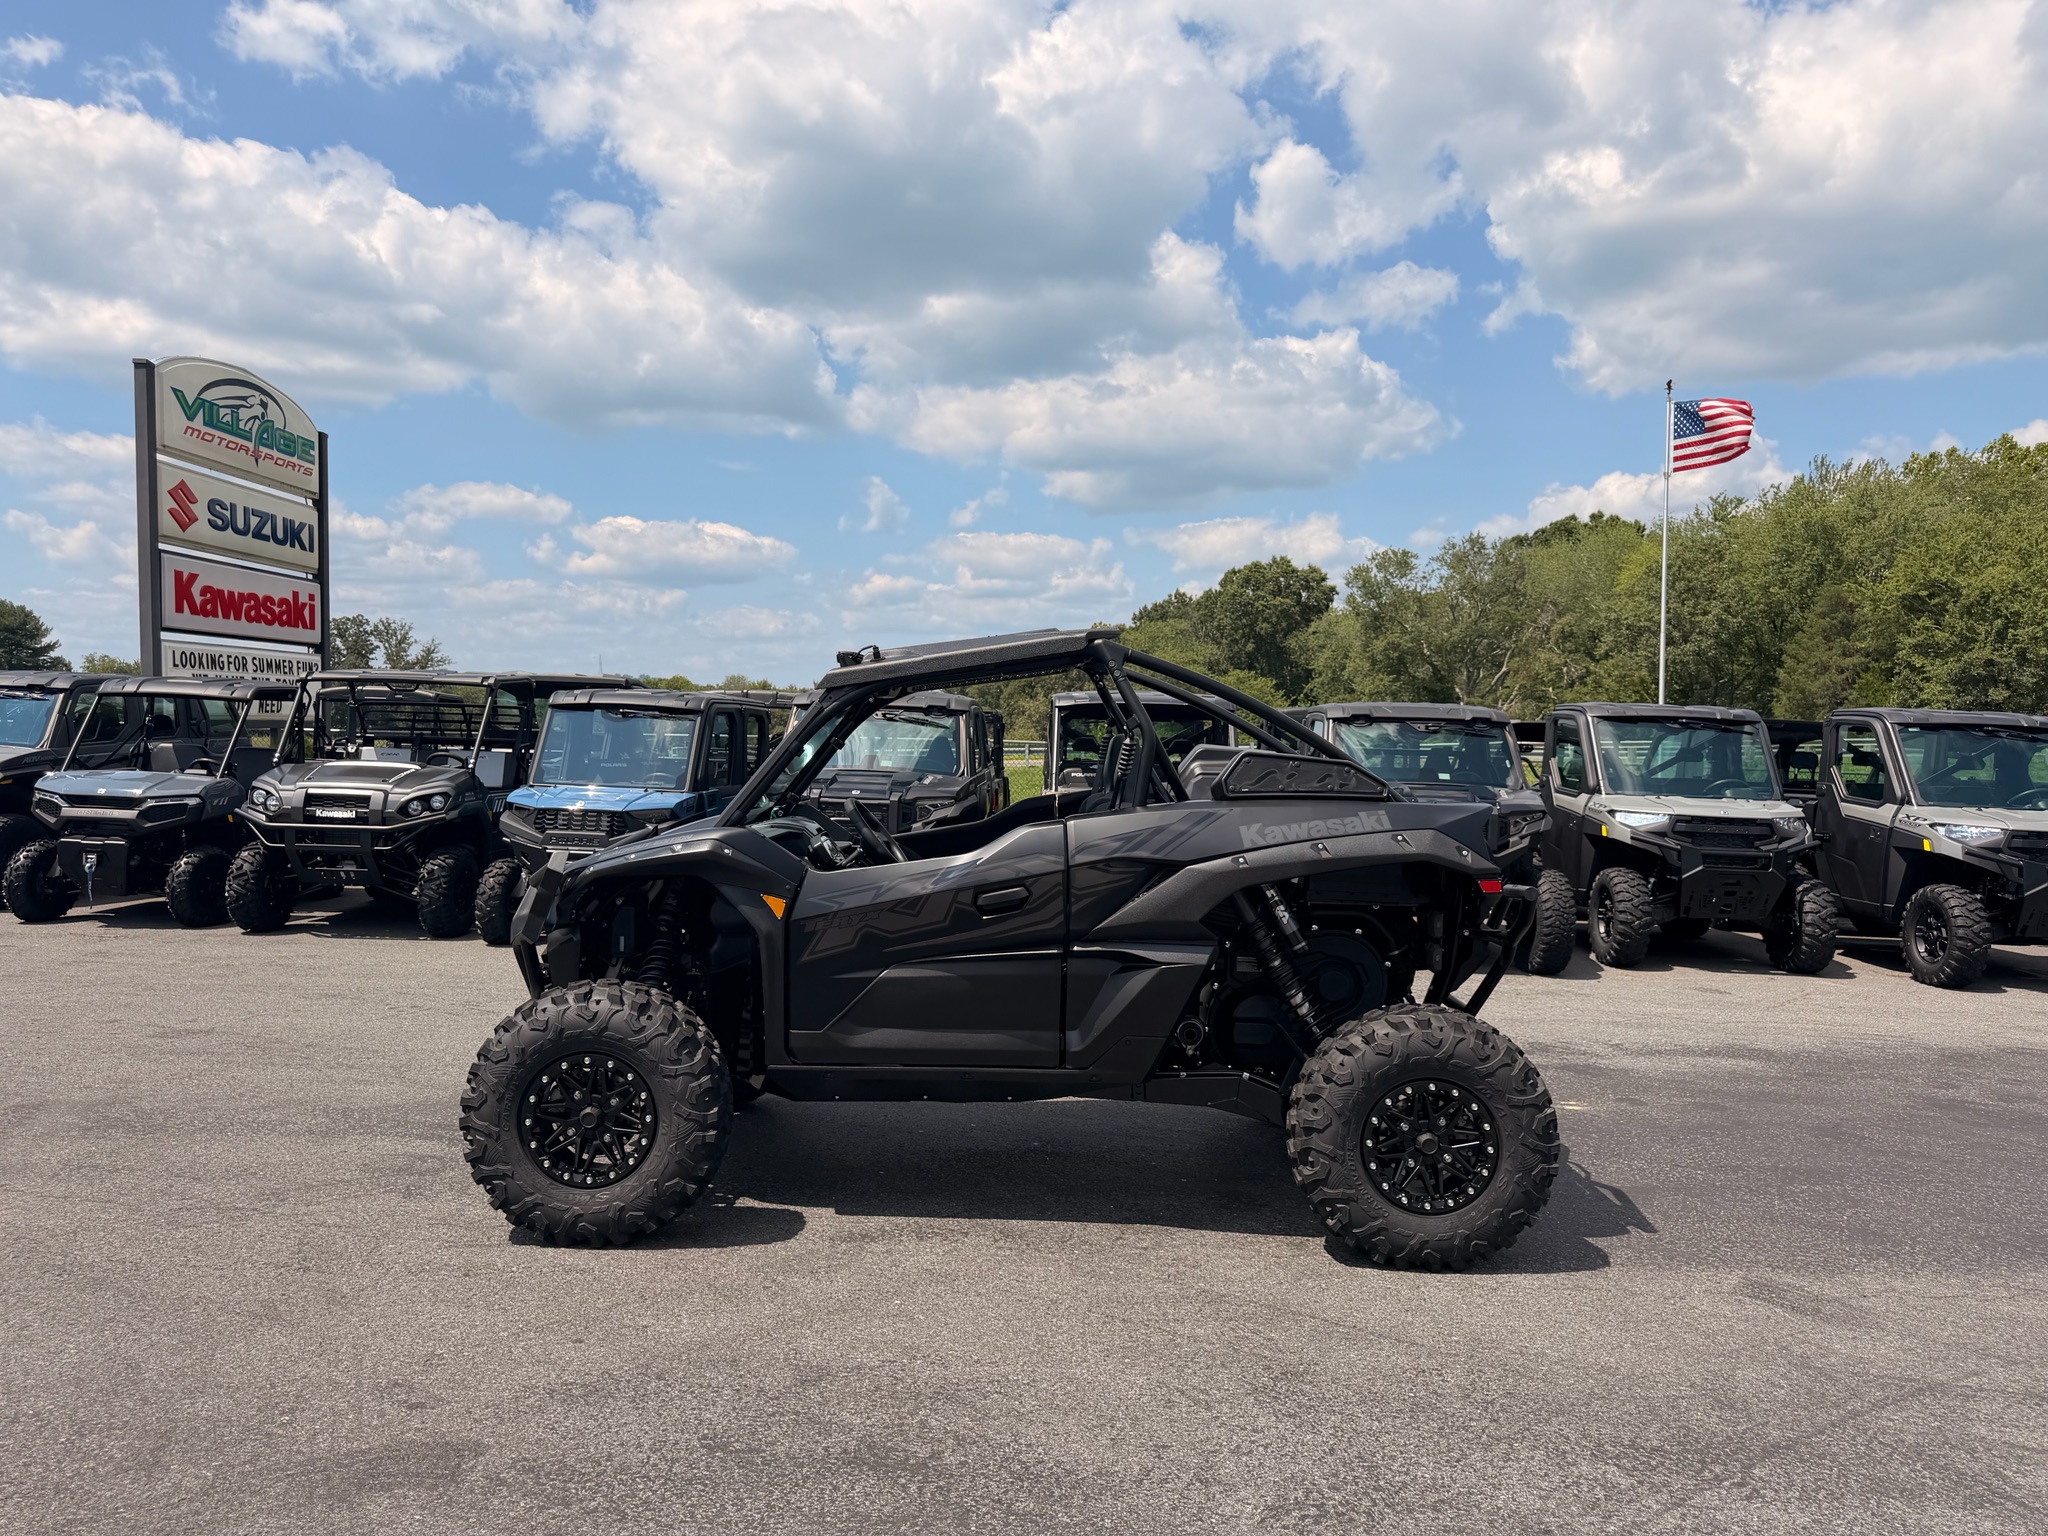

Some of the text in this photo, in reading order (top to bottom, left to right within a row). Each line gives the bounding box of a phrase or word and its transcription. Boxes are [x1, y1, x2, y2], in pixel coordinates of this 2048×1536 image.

[170, 386, 315, 466] VILLAGE
[183, 425, 314, 477] MOTORSPORTS
[207, 498, 314, 553] SUZUKI
[173, 569, 316, 630] Kawasaki
[172, 650, 319, 676] LOOKING FOR SUMMER FUN?
[258, 700, 283, 714] NEED
[21, 754, 41, 765] ADV
[315, 808, 356, 819] Kawasaki
[1589, 801, 1608, 809] XP
[1898, 819, 1922, 829] 1000
[1900, 813, 1929, 823] XP
[1239, 810, 1393, 849] Kawasaki
[549, 836, 600, 846] POLARIS
[1346, 1141, 1391, 1217] CARNIVORE
